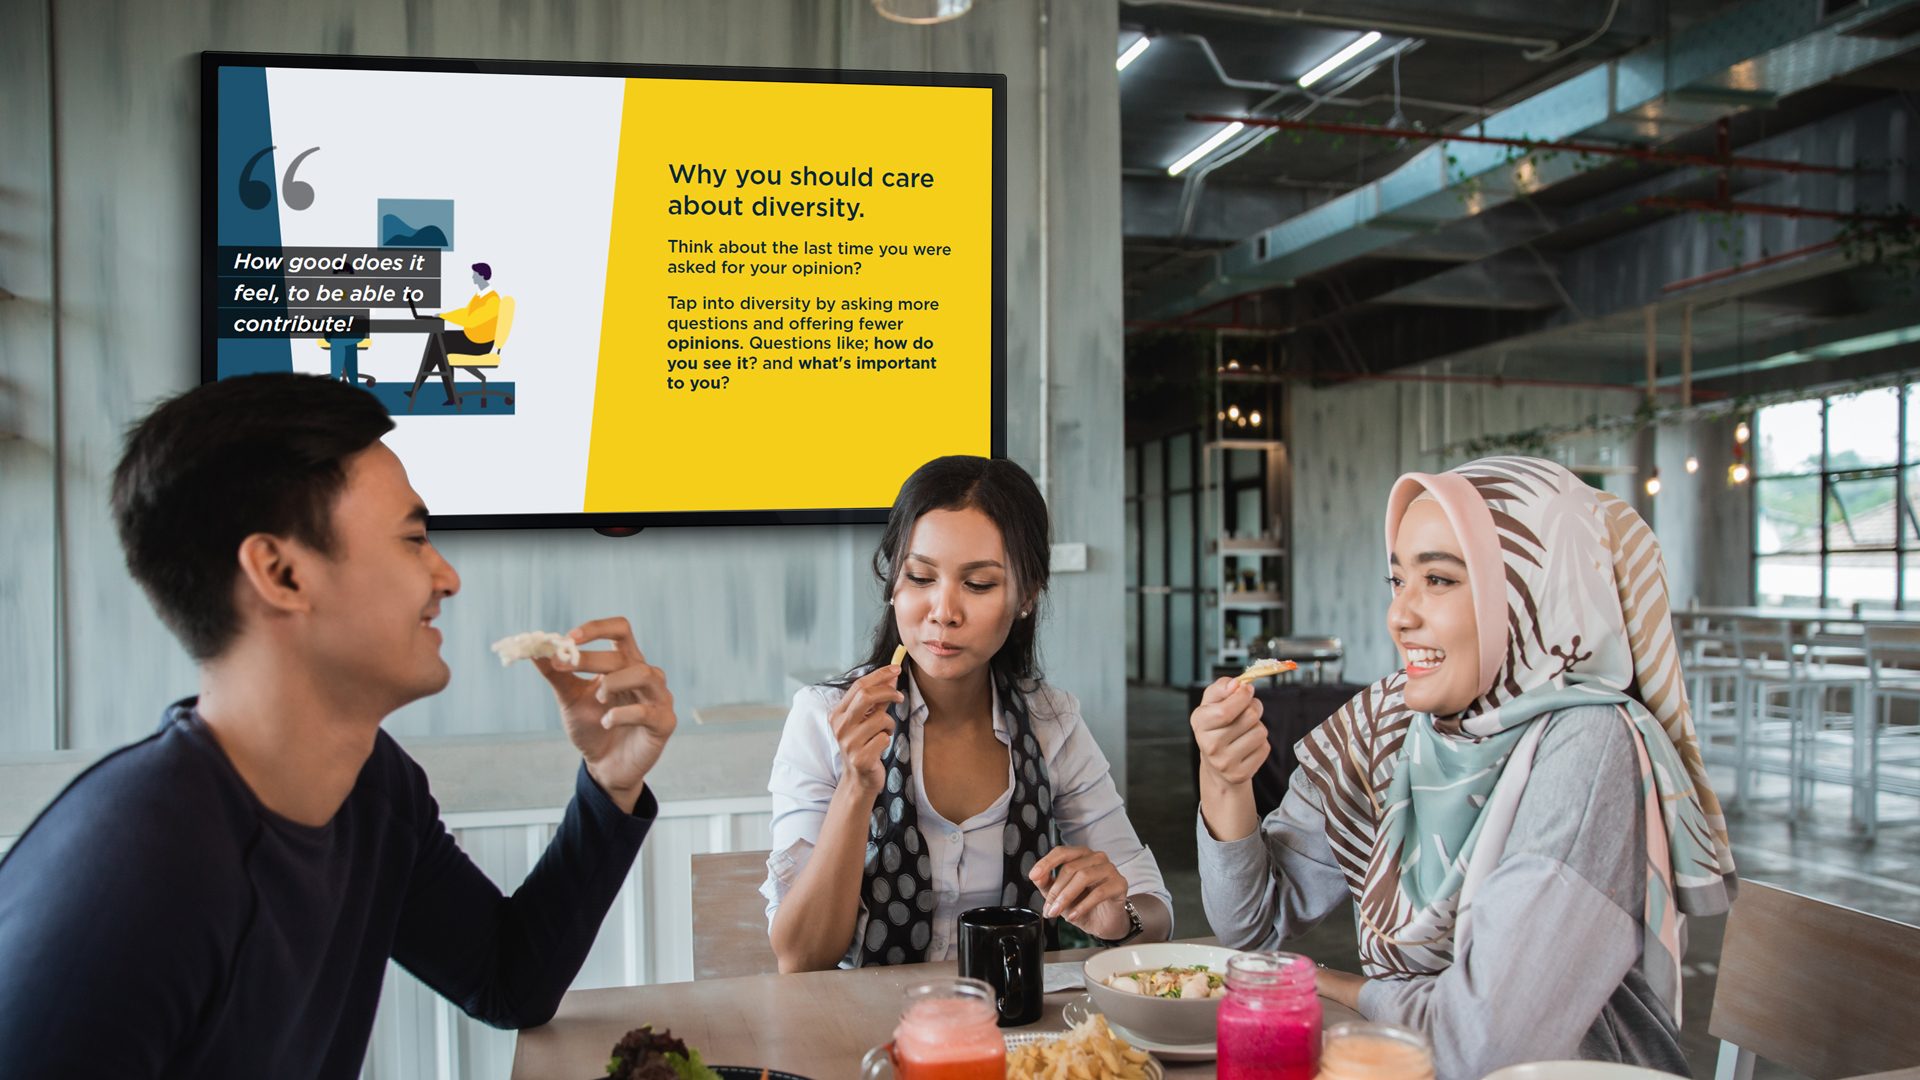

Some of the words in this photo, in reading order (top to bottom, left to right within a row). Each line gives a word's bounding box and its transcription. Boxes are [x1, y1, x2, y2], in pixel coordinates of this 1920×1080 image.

[668, 163, 727, 189] Why
[735, 169, 782, 189] you
[790, 165, 873, 187] should
[881, 171, 935, 188] care
[668, 194, 743, 216] about
[751, 195, 865, 222] diversity.
[667, 239, 714, 254] Think
[718, 240, 767, 254] about
[772, 240, 799, 255] the
[804, 240, 833, 255] last
[837, 241, 874, 256] time
[878, 244, 908, 258] you
[913, 245, 952, 256] were
[233, 253, 284, 270] How
[288, 253, 347, 274] good
[352, 253, 404, 271] does
[409, 254, 426, 271] it
[667, 259, 716, 274] asked
[721, 260, 746, 274] for
[750, 263, 788, 277] your
[792, 261, 862, 277] opinion?
[234, 283, 279, 304] feel,
[288, 285, 310, 302] to
[315, 284, 344, 302] be
[349, 284, 396, 302] able
[402, 286, 424, 302] to
[667, 295, 698, 313] Tap
[703, 295, 735, 310] into
[740, 296, 811, 313] diversity
[816, 296, 836, 313] by
[841, 296, 893, 313] asking
[898, 300, 940, 311] more
[233, 314, 355, 332] contribute!
[667, 316, 748, 333] questions
[753, 316, 784, 330] and
[788, 316, 854, 333] offering
[858, 316, 904, 331] fewer
[667, 335, 744, 352] opinions.
[749, 335, 832, 350] Questions
[837, 335, 869, 352] like;
[874, 336, 908, 350] how
[912, 336, 934, 350] do
[667, 359, 698, 373] you
[703, 359, 732, 370] see
[737, 356, 758, 370] it?
[762, 356, 793, 370] and
[798, 355, 852, 370] what's
[856, 355, 937, 372] important
[666, 376, 685, 390] to
[689, 375, 730, 392] you?
